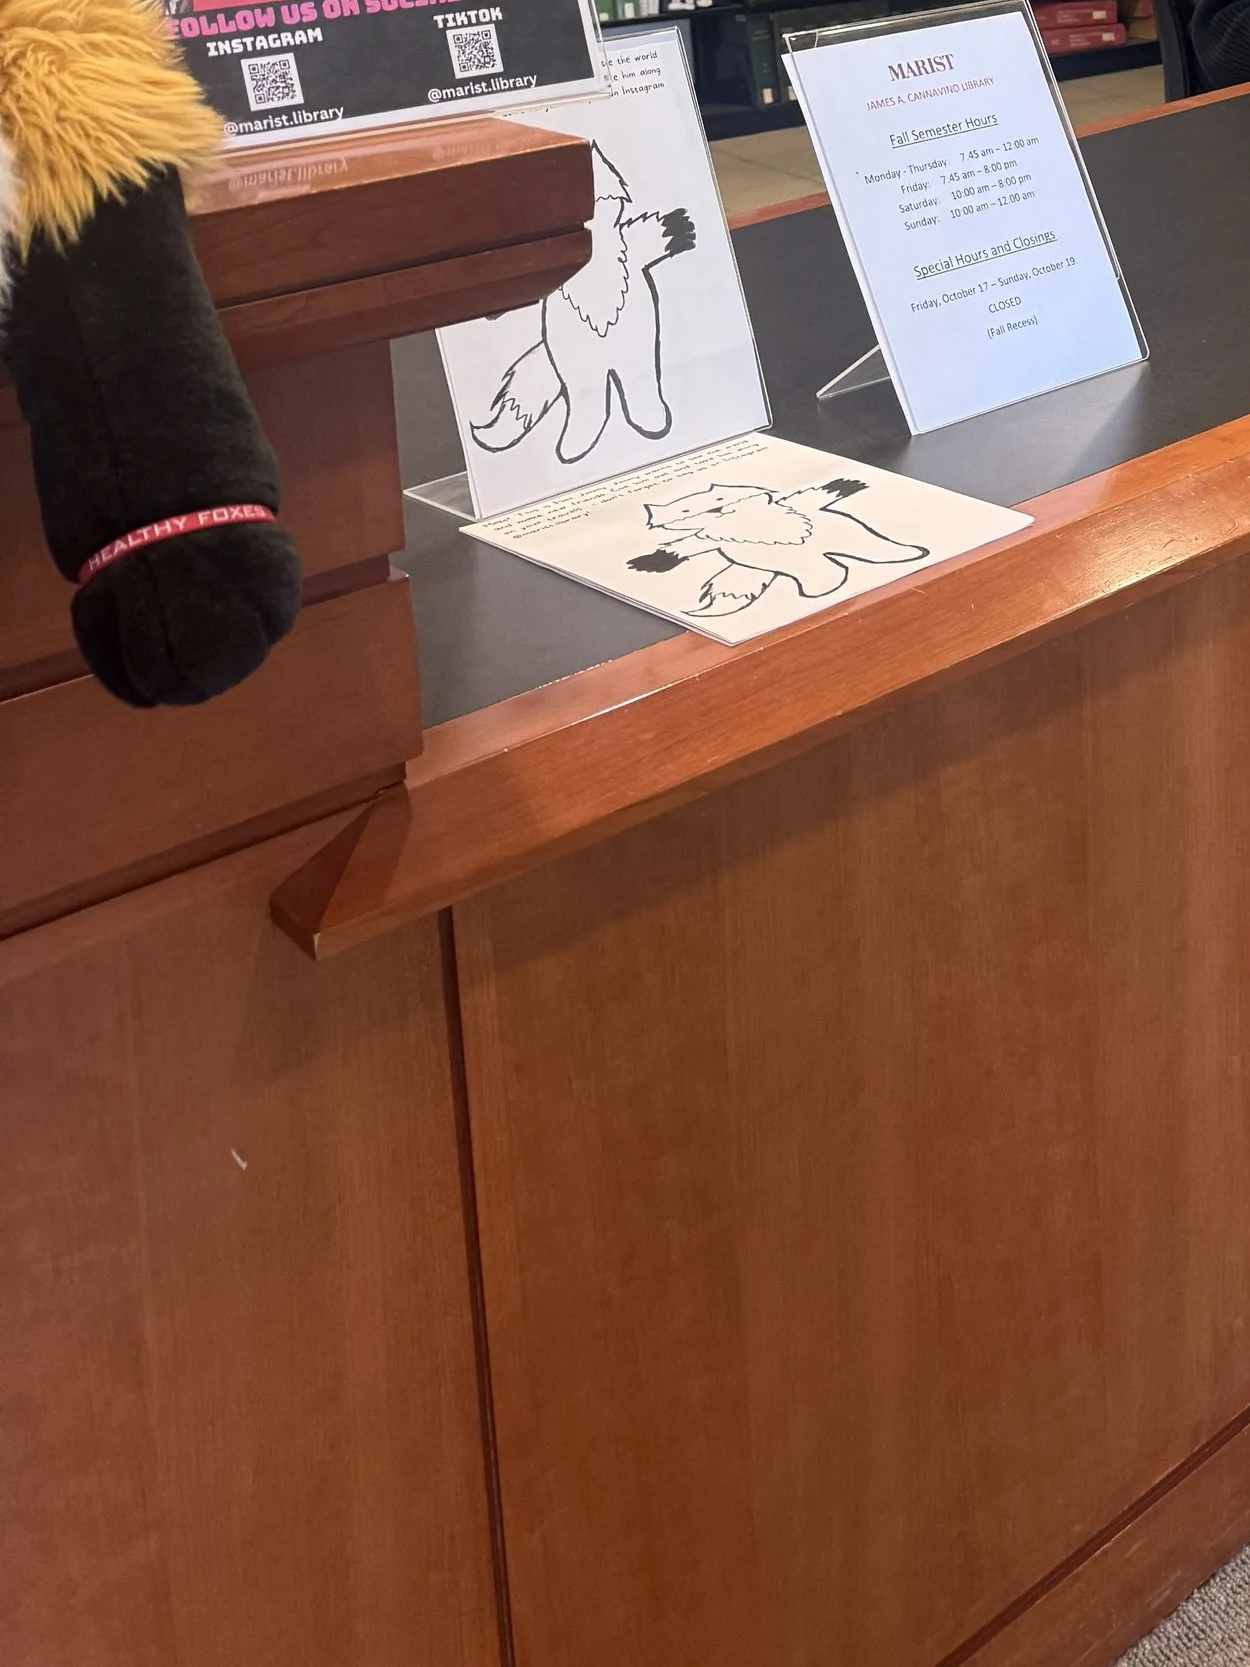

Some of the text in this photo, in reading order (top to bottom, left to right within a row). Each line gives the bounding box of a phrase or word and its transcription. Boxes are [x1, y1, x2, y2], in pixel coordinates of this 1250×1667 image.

[281, 1, 318, 25] US
[433, 7, 503, 29] TIKTOK
[206, 27, 323, 57] INSTAGRAM
[617, 55, 631, 65] the
[634, 50, 658, 62] world
[888, 54, 954, 81] MARIST
[427, 74, 538, 103] @marist.library
[622, 82, 665, 95] Instagram
[867, 77, 994, 110] JAMES A. CANNAVINO LIBRARY
[224, 107, 344, 136] @marist.library
[889, 114, 998, 146] Fall Semester Hours
[864, 169, 901, 185] Monday
[908, 159, 949, 175] Thursday:
[981, 147, 994, 156] am
[1002, 139, 1025, 151] 12:00
[1026, 137, 1040, 146] am
[900, 181, 931, 195] Friday:
[962, 170, 976, 179] am
[983, 162, 1002, 174] 8:00
[1004, 159, 1018, 171] pm
[898, 196, 941, 214] Saturday:
[951, 187, 976, 201] 10:00
[976, 183, 990, 192] am
[998, 176, 1017, 188] 8:00
[1018, 173, 1032, 185] pm
[904, 215, 940, 231] Sunday:
[950, 205, 974, 219] 10:00
[976, 201, 989, 210] am
[1022, 190, 1036, 200] am
[913, 230, 1056, 278] Special Hours and Closings
[910, 297, 942, 313] Friday,
[942, 287, 976, 304] October
[978, 282, 989, 293] 17
[998, 271, 1031, 287] Sunday,
[1032, 261, 1064, 276] October
[988, 296, 1021, 313] CLOSED
[987, 315, 1039, 340] (Fall Recess)
[88, 504, 266, 571] HEALTHY FOXES
